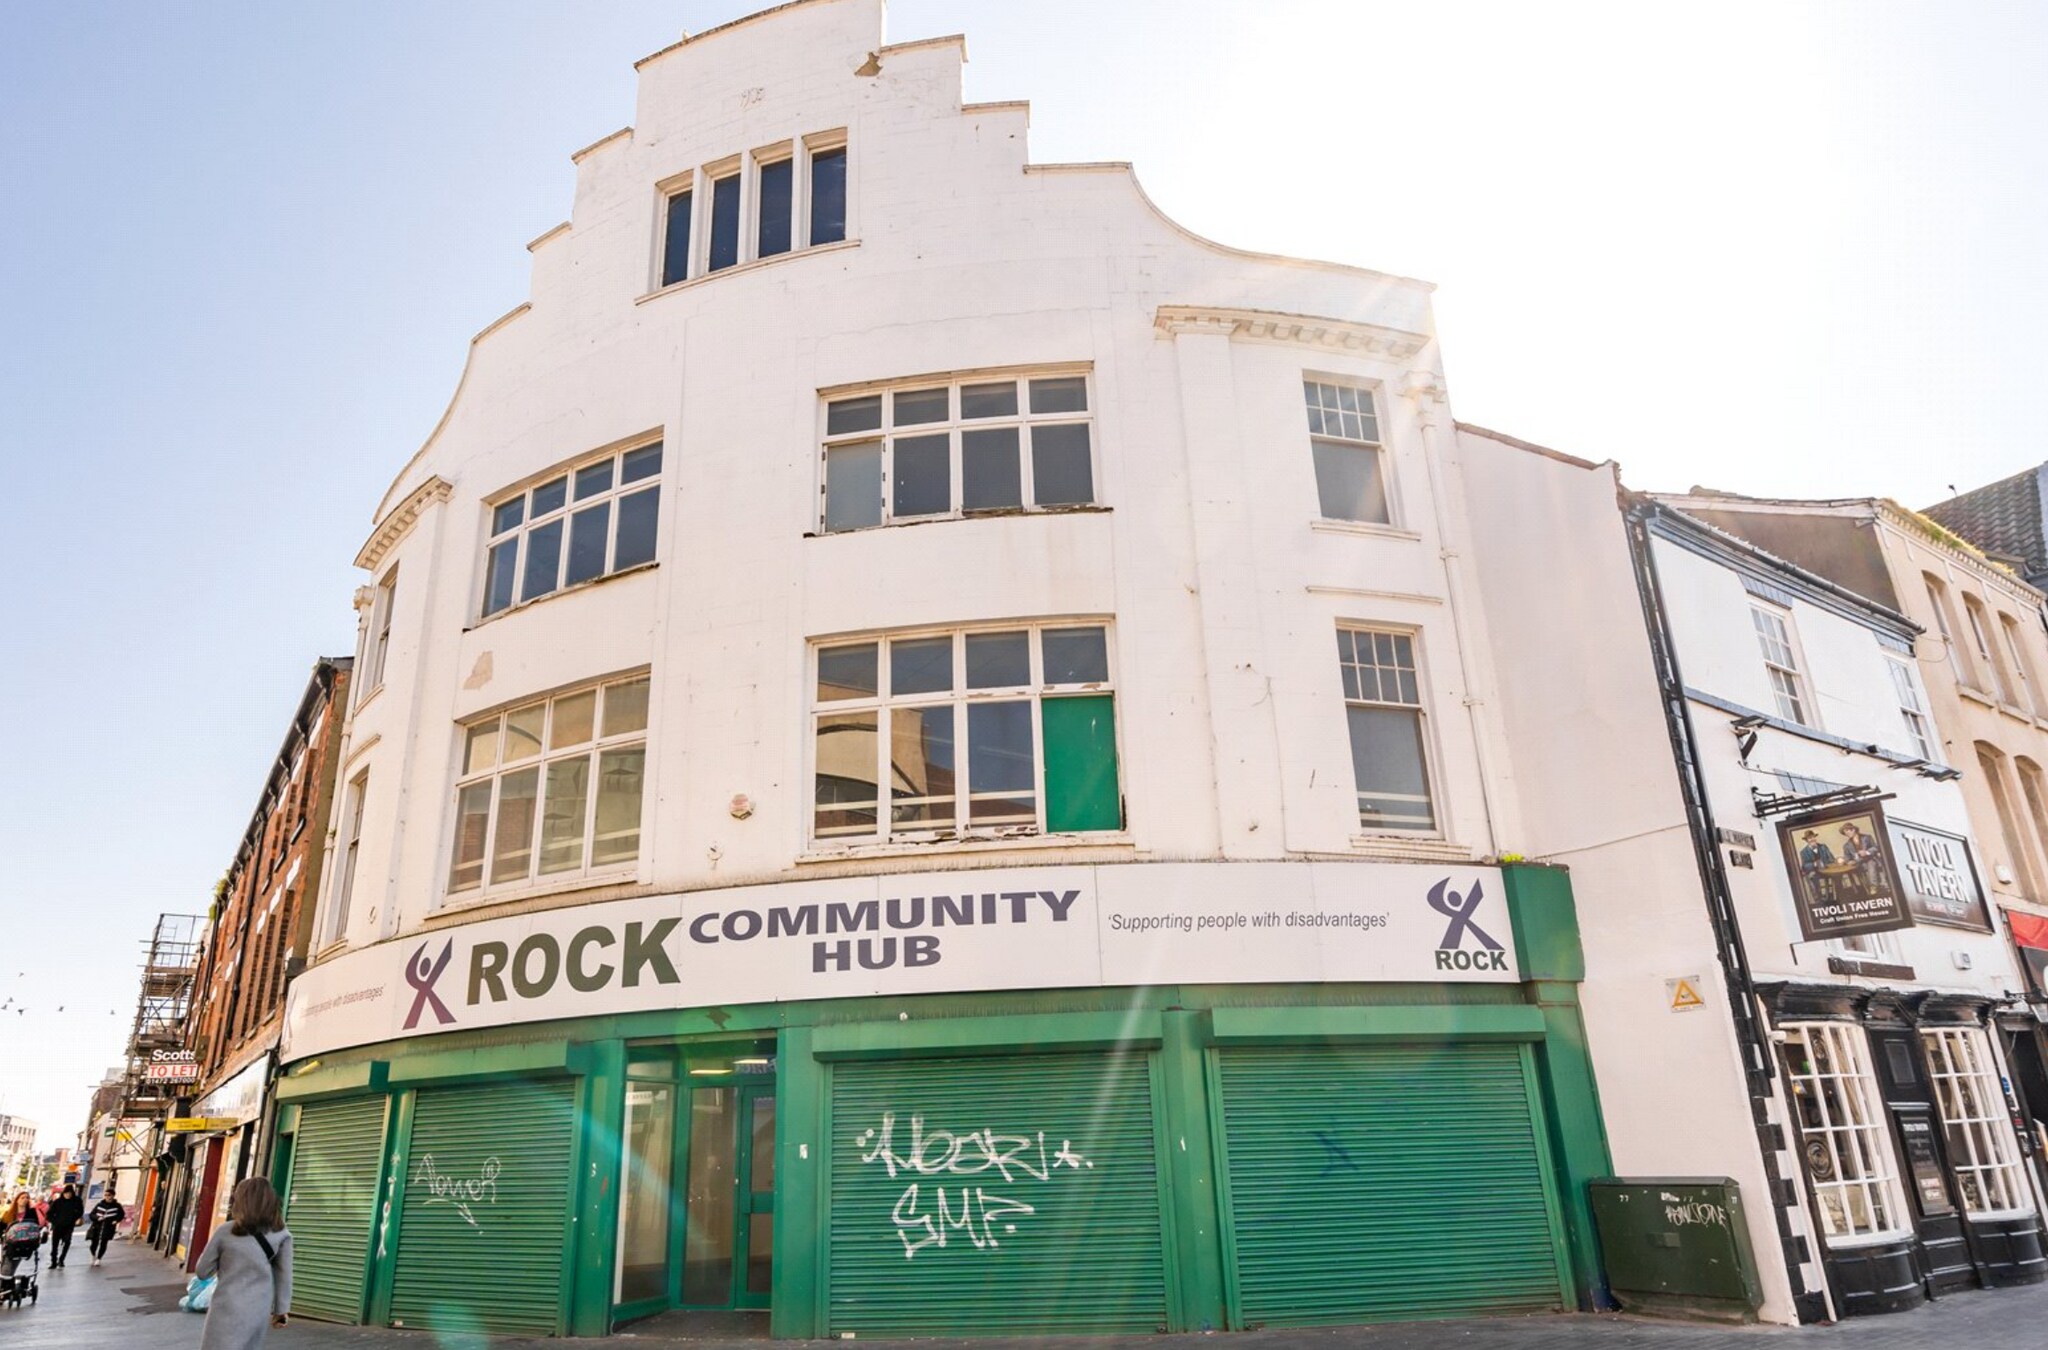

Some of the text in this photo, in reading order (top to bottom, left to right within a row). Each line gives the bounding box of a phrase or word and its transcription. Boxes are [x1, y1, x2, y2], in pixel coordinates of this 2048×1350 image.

[1906, 866, 1971, 904] TAVERN
[689, 890, 1081, 943] COMMUNITY
[1812, 897, 1893, 918] TIVOLI TAVERN
[1197, 911, 1247, 932] people
[1251, 911, 1281, 927] with
[466, 916, 683, 1006] ROCK
[812, 935, 942, 973] HUB
[1434, 949, 1509, 971] ROCK
[152, 1048, 196, 1061] Scotts
[150, 1063, 196, 1078] TO LET
